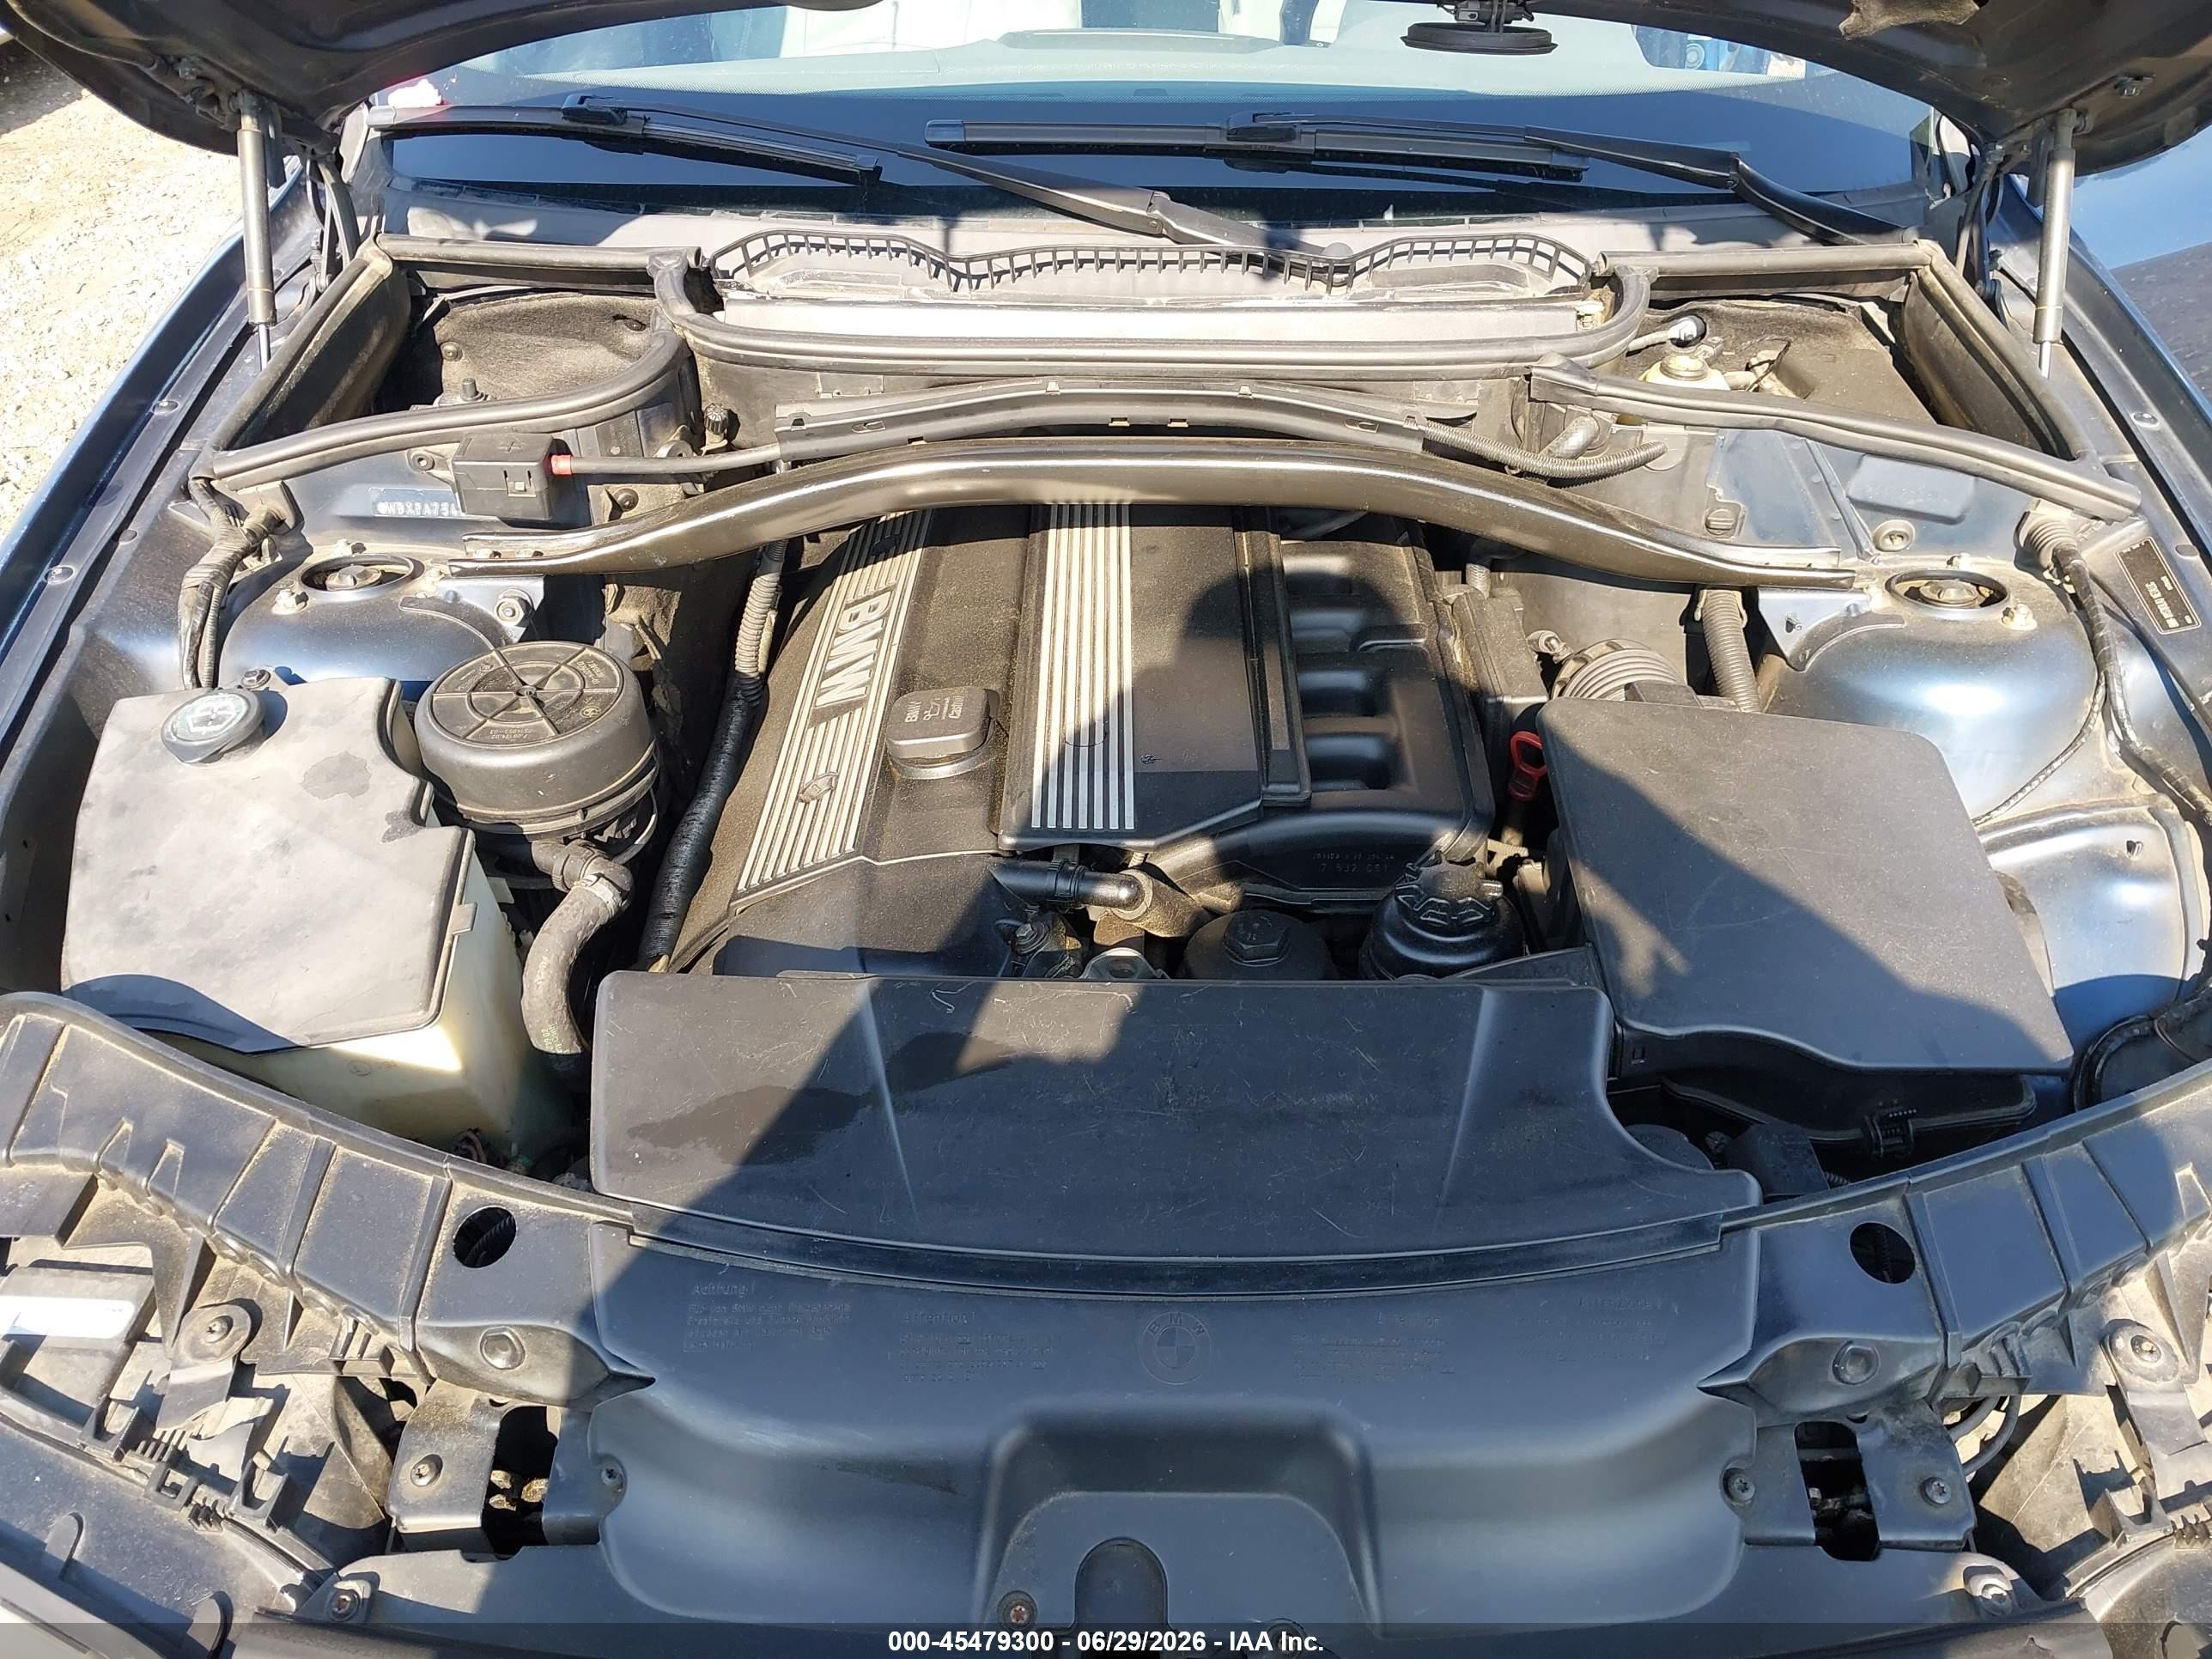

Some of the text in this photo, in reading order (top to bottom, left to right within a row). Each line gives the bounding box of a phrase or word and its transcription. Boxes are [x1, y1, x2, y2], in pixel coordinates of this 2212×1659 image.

[815, 590, 893, 707] BMW
[904, 700, 922, 723] BMW
[1146, 1312, 1206, 1338] BMW
